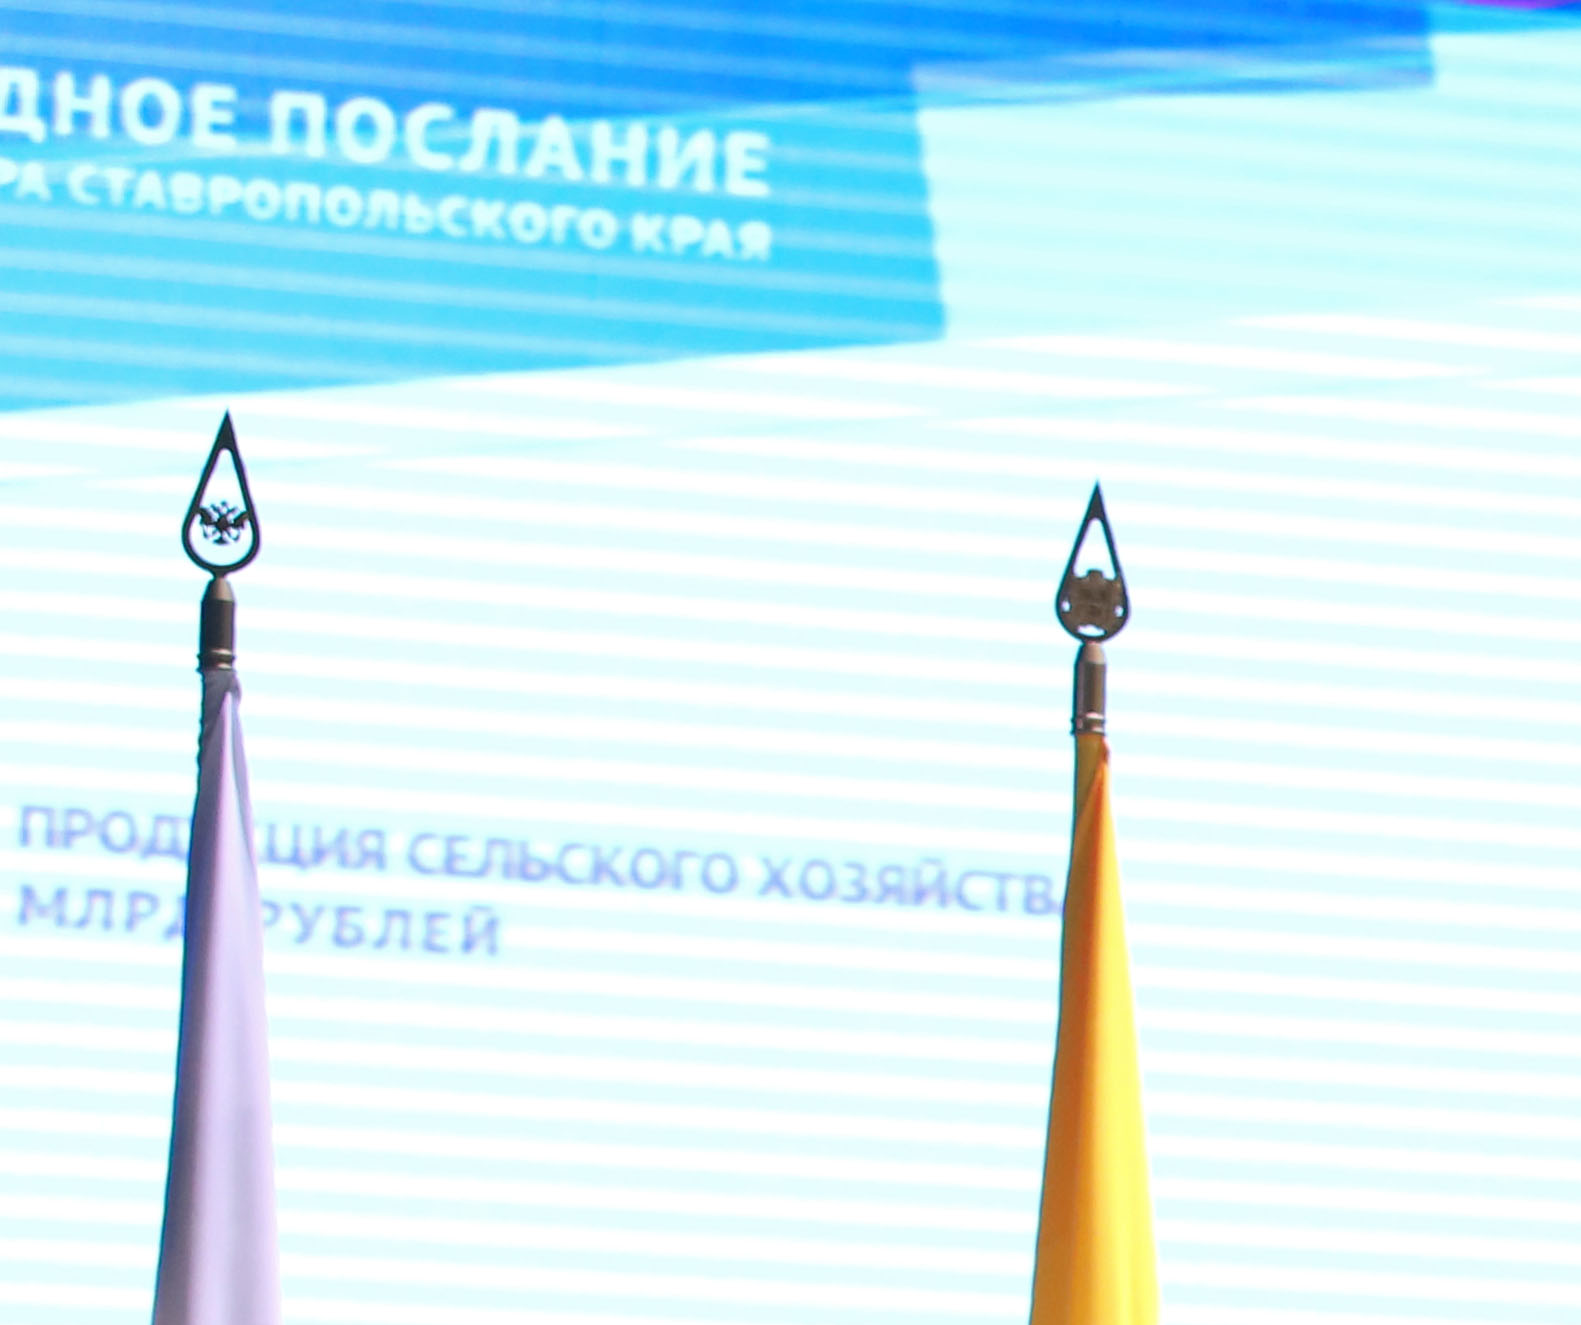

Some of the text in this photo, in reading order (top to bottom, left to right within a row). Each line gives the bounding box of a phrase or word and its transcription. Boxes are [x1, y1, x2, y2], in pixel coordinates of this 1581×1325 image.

[270, 90, 771, 197] ПОСЛАНИЕ
[67, 164, 616, 252] СТАВРОПОЛЬСКОГО
[631, 213, 772, 262] КРАЯ
[19, 804, 1065, 917] ПРОДЦИЯ СЕЛЬСКОГО ХОЗЯЙСТВ
